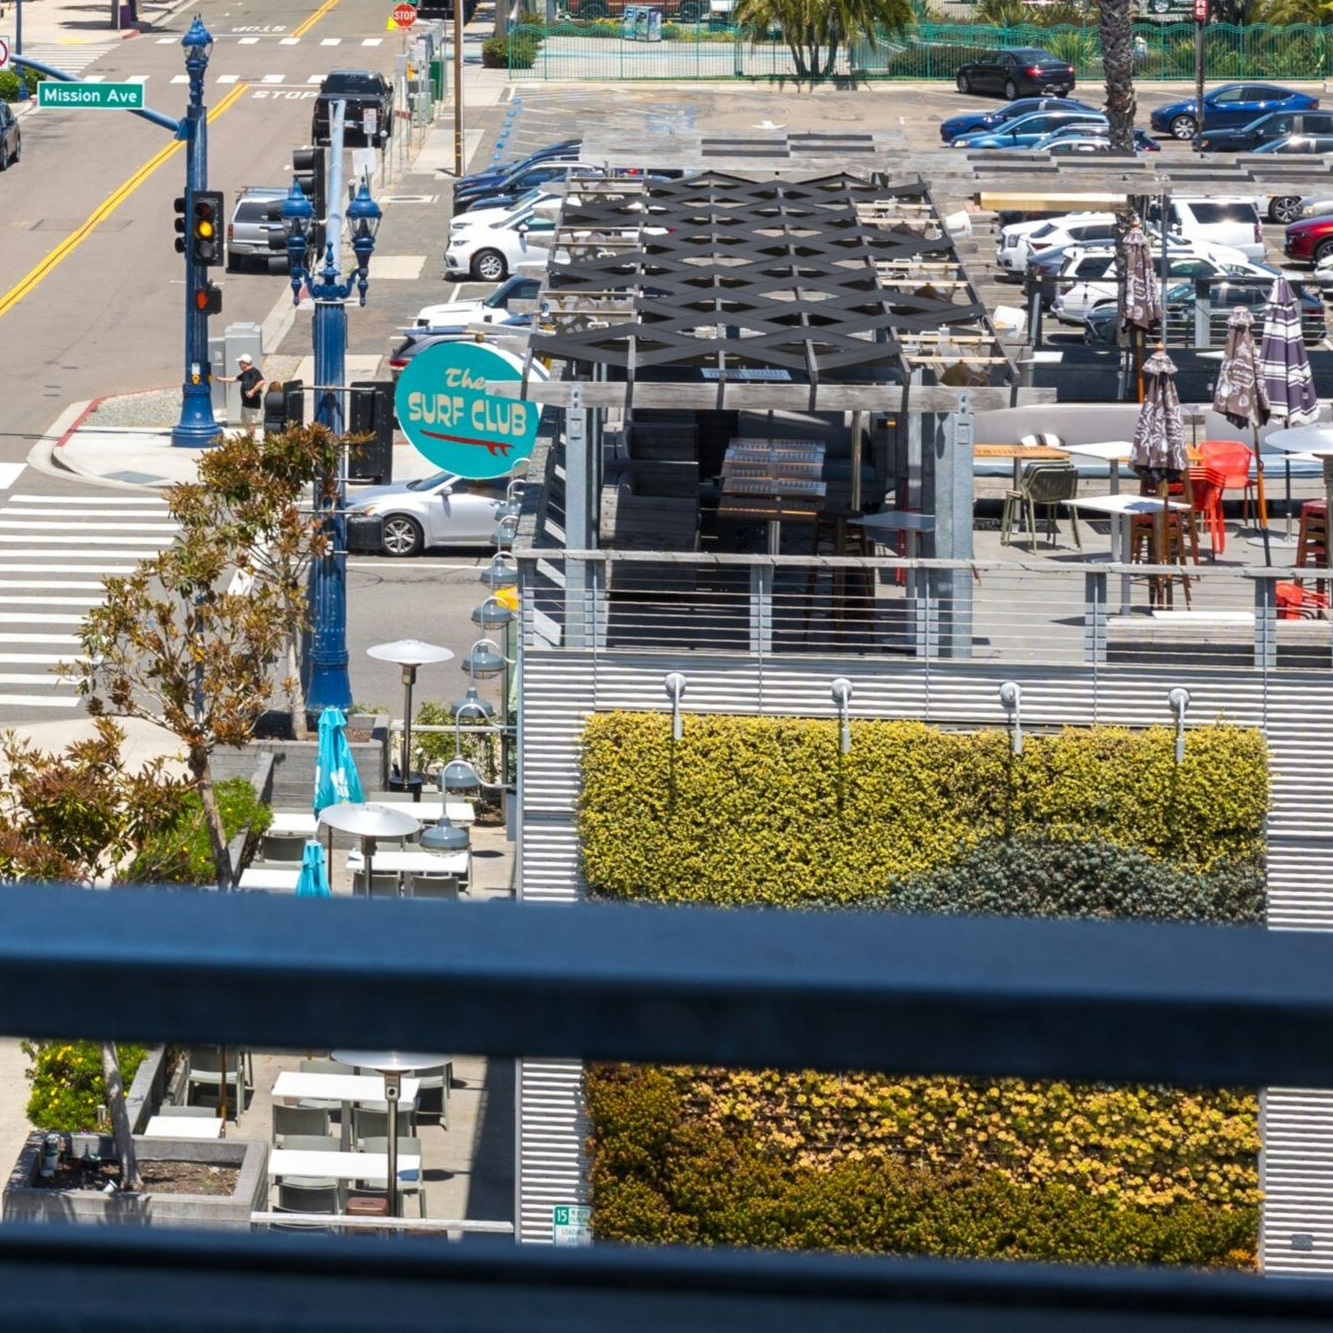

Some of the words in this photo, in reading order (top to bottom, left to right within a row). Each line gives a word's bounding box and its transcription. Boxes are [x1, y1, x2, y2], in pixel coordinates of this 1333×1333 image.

[394, 10, 416, 21] STOP
[44, 88, 100, 103] Mission
[107, 89, 138, 103] Ave
[251, 90, 319, 100] STOP
[445, 368, 486, 390] The
[408, 391, 465, 427] SURF
[471, 399, 526, 436] CLUB
[556, 1209, 568, 1223] 15
